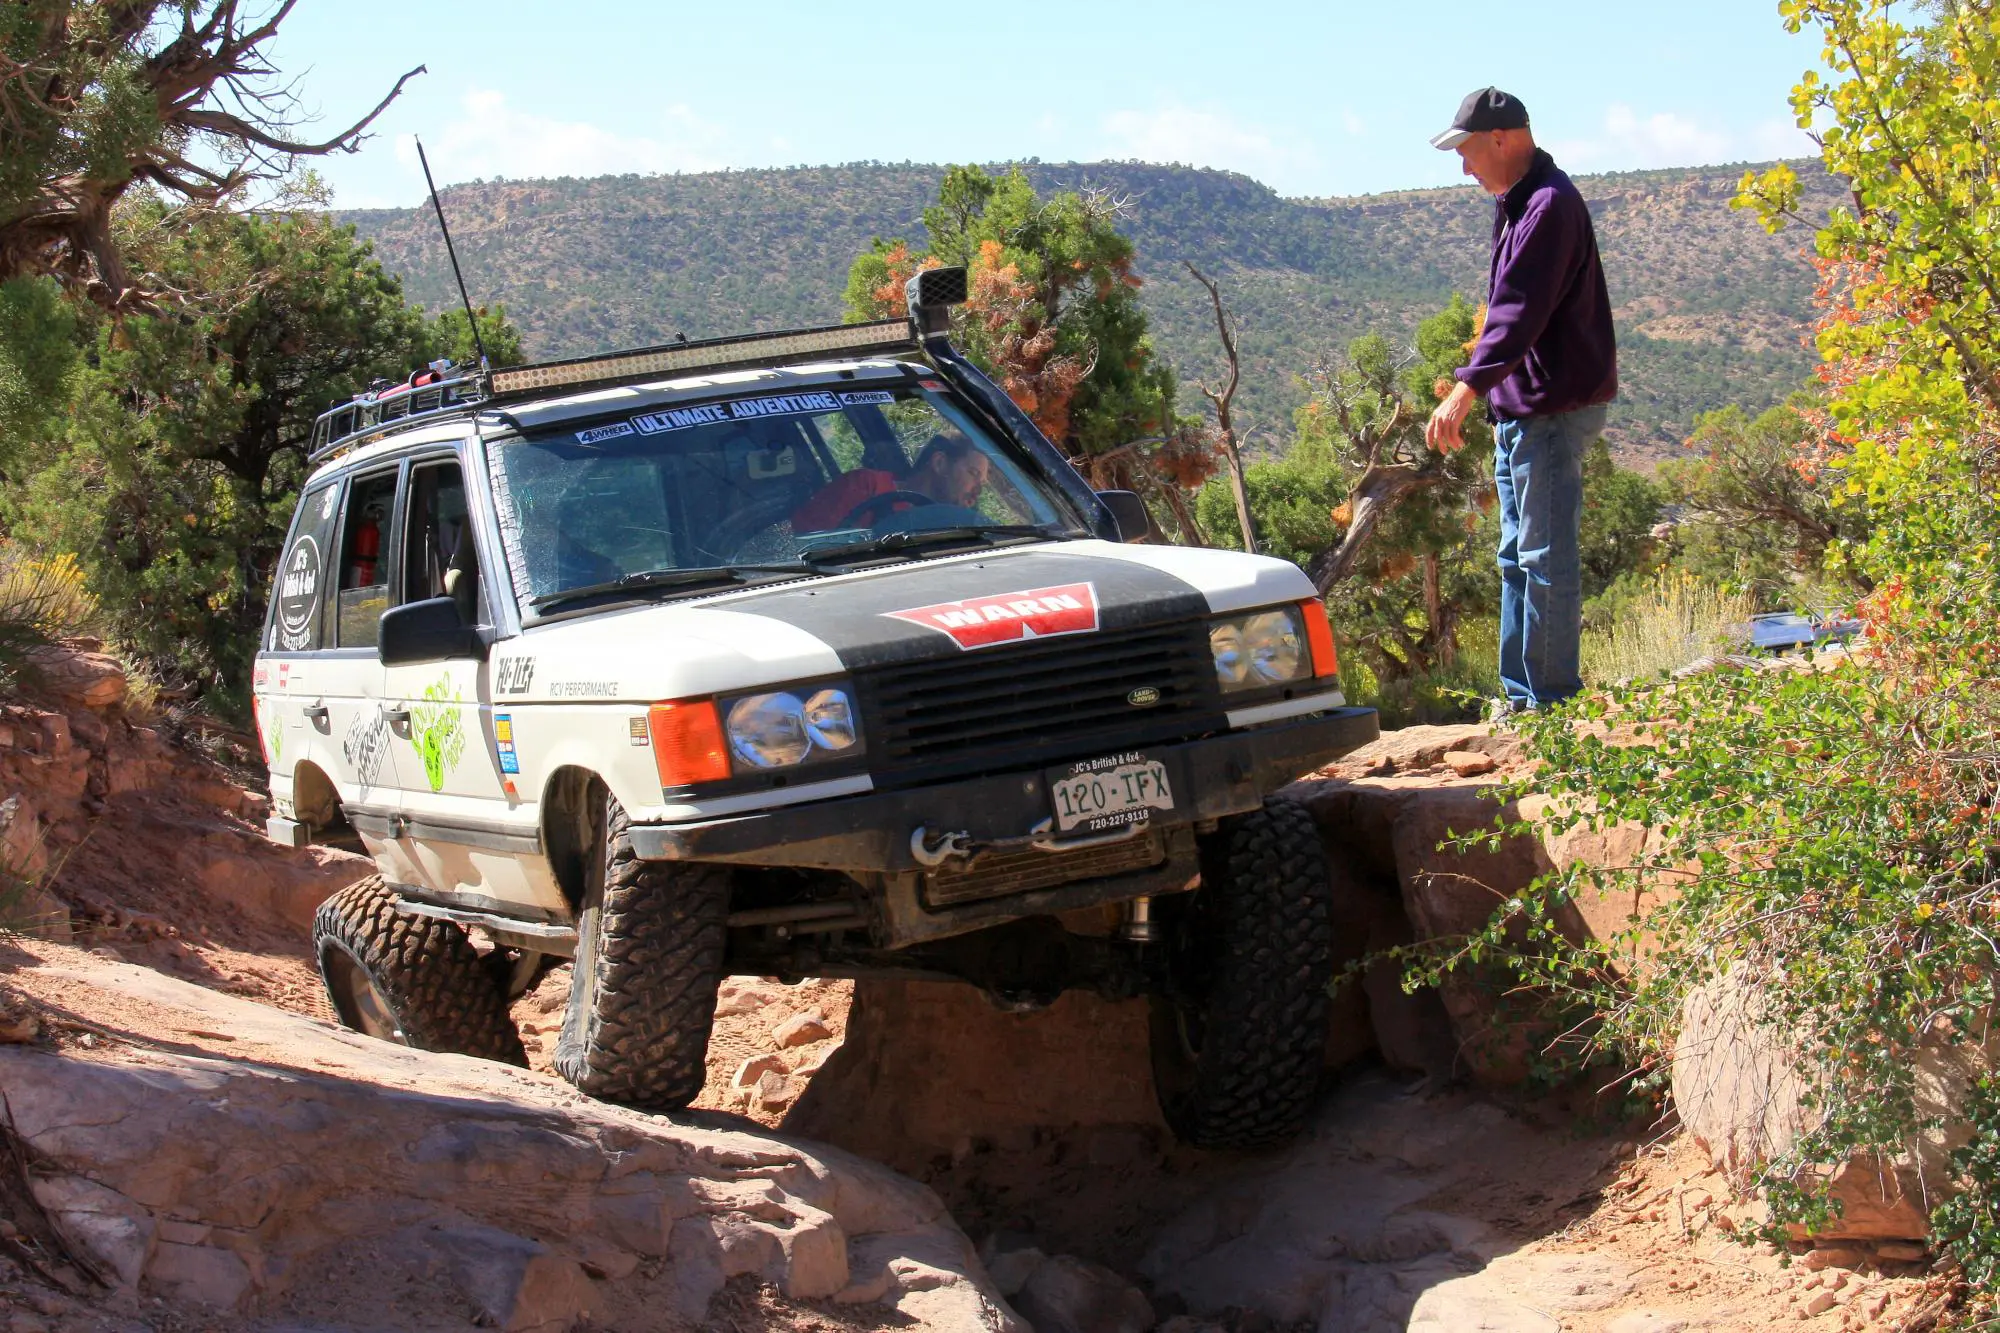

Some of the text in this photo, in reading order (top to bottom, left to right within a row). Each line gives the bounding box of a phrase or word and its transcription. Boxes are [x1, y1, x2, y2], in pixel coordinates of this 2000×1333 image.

[634, 392, 838, 434] ULTIMATE ADVENTURE
[932, 594, 1083, 627] WARN
[550, 681, 619, 696] RCV PERFORMANCE
[1134, 689, 1150, 697] LAND
[1075, 752, 1139, 774] JC's British & 4x4
[1090, 809, 1149, 831] 720-227-9118
